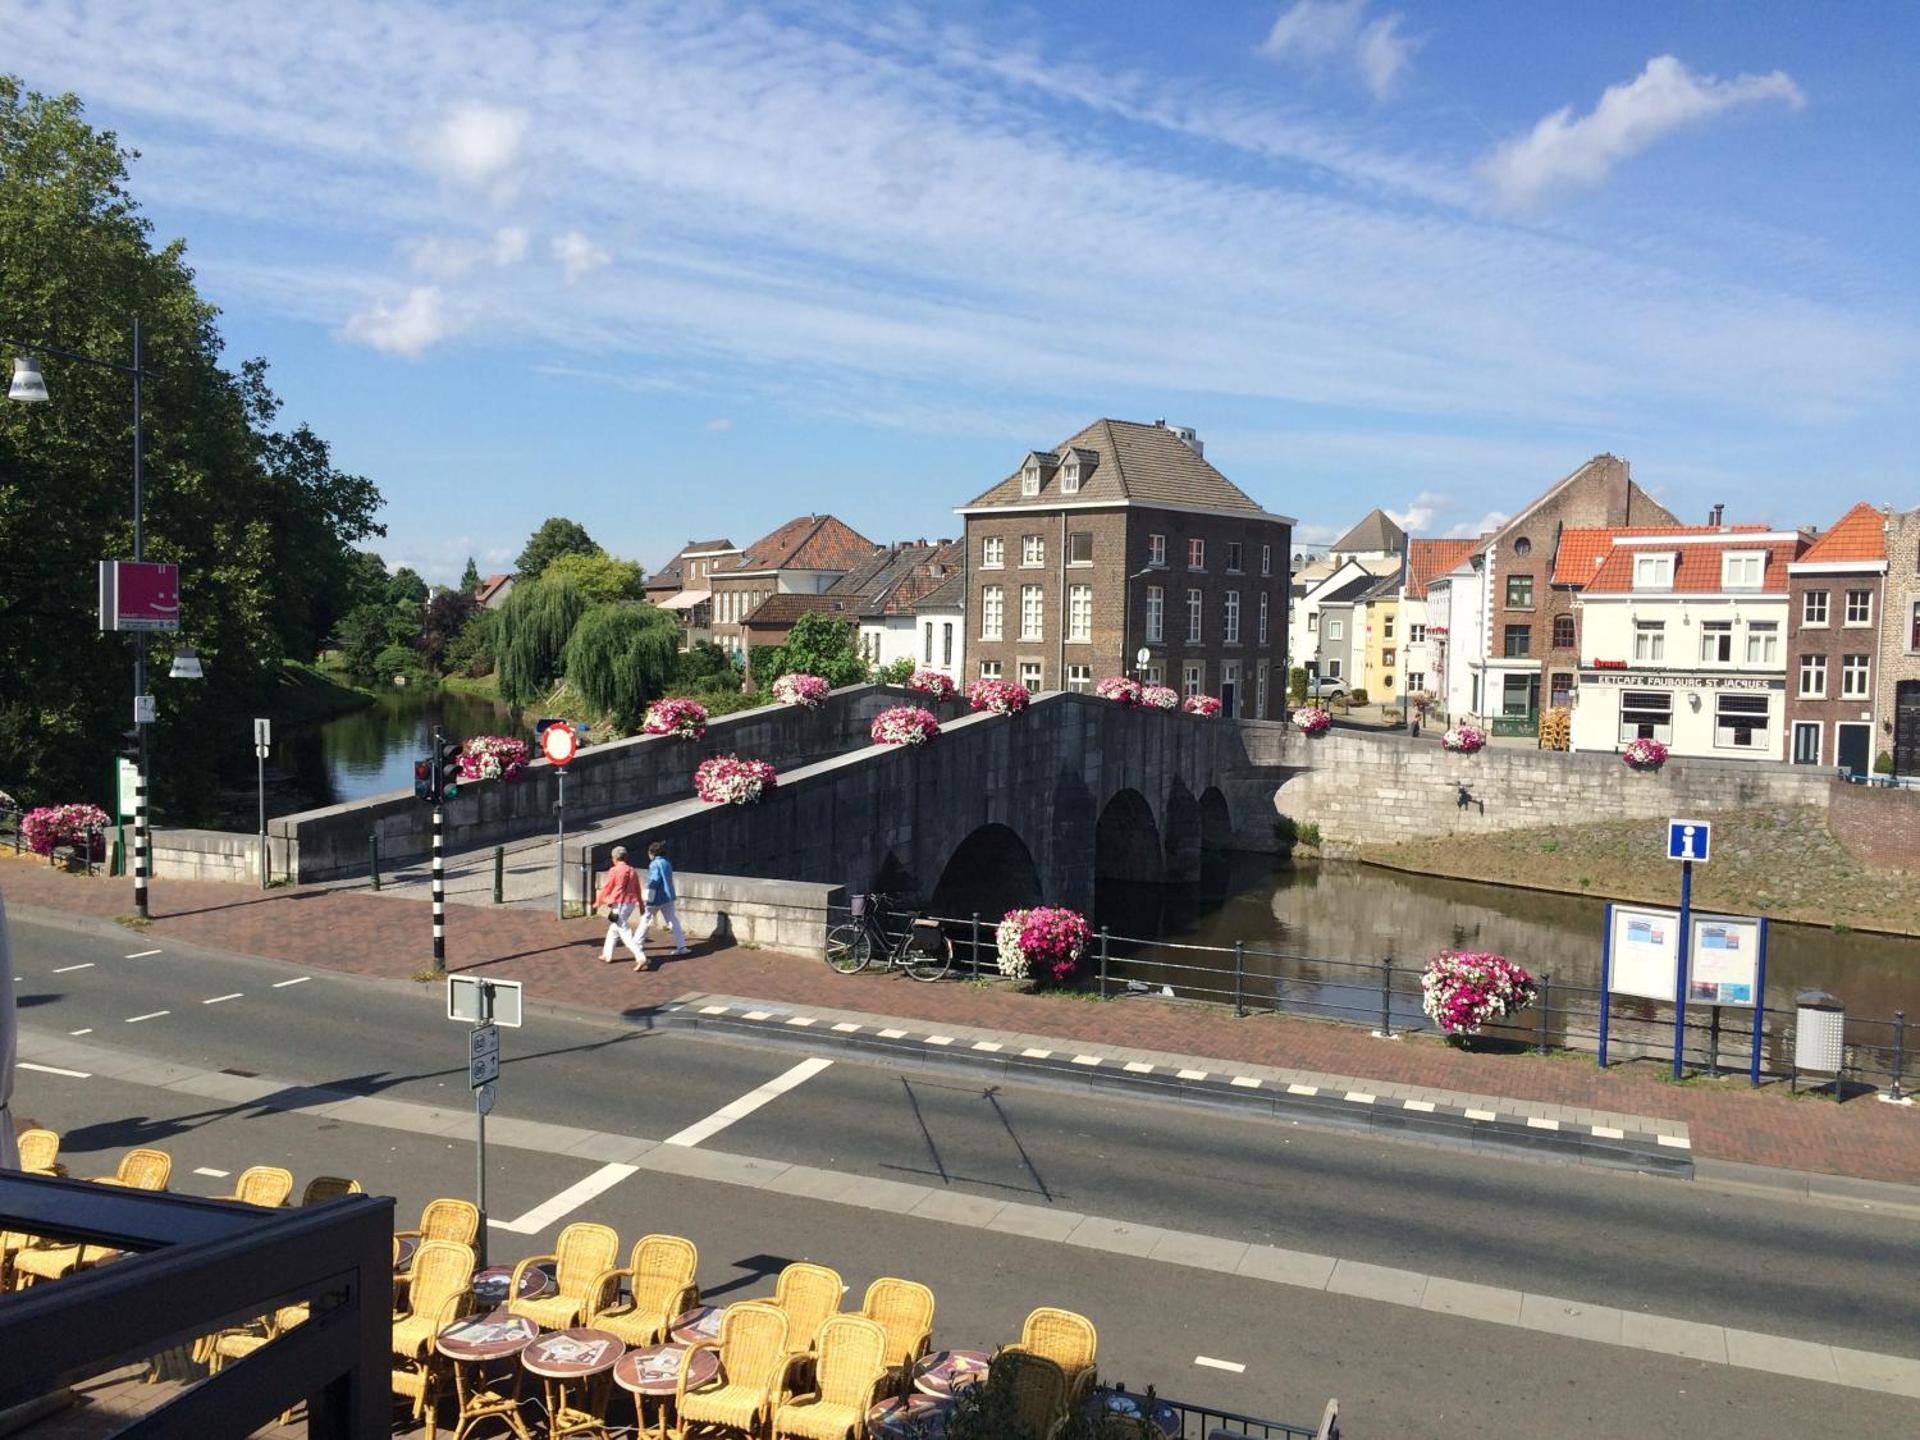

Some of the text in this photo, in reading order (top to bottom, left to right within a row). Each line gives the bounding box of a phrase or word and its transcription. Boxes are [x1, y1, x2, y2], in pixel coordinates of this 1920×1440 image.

[1648, 677, 1702, 687] FAUBOURG
[1705, 678, 1719, 688] ST
[1723, 679, 1770, 689] JACQUES
